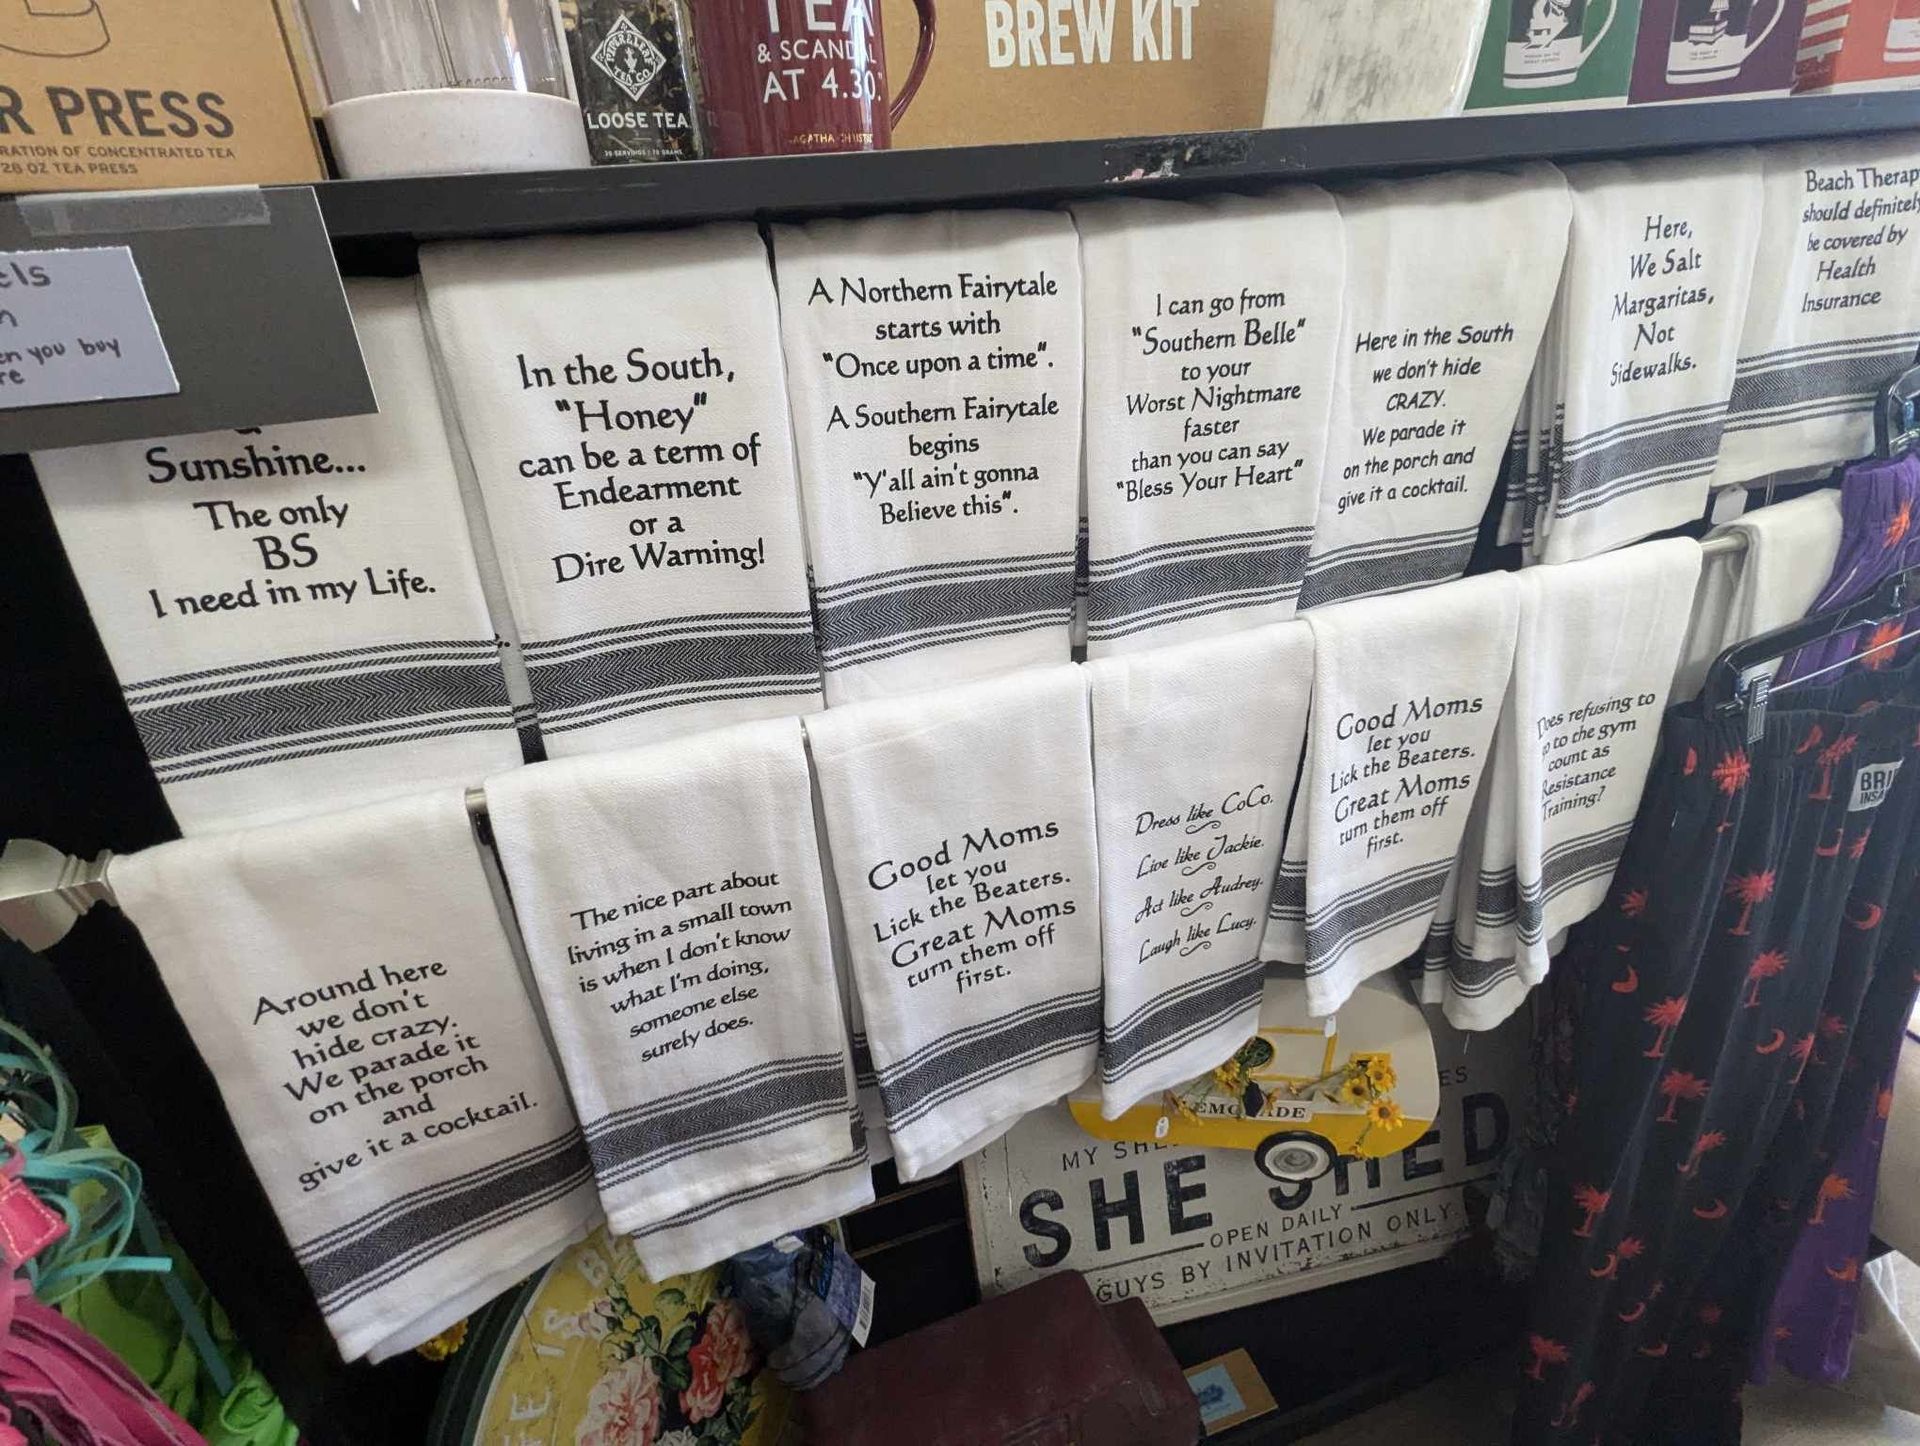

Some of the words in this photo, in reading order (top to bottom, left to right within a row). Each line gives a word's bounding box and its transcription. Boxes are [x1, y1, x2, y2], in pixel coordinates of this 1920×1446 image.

[985, 0, 1115, 68] BREW
[1132, 0, 1200, 62] KIT
[757, 44, 772, 63] &
[764, 69, 805, 103] AT
[46, 85, 235, 138] PRESS
[587, 112, 648, 129] LOOSE
[653, 112, 689, 128] TEA
[53, 163, 85, 174] TEA
[89, 163, 138, 174] PRESS
[63, 145, 82, 157] OF
[88, 146, 205, 158] CONCENTRATED
[207, 147, 236, 159] TEA
[1805, 169, 1855, 193] Beach
[1643, 214, 1693, 243] Here,
[1802, 199, 1853, 224] should
[1806, 232, 1821, 252] be
[1822, 224, 1887, 251] covered
[1886, 223, 1909, 247] by
[1630, 252, 1657, 281] We
[1661, 246, 1703, 275] Salt
[1815, 254, 1877, 282] Health
[807, 276, 835, 307] A
[839, 276, 954, 307] Northern
[957, 270, 1059, 304] Fairytale
[1611, 285, 1715, 321] Margaritas,
[1800, 290, 1882, 314] Insurance
[874, 319, 943, 341] starts
[946, 309, 1002, 337] with
[1131, 325, 1237, 356] "Southern
[1243, 316, 1307, 347] Belle"
[1354, 330, 1398, 355] Here
[1401, 327, 1419, 348] in
[1423, 325, 1453, 347] the
[1456, 321, 1515, 345] South
[1633, 320, 1676, 352] Not
[27, 342, 66, 365] you
[77, 338, 121, 358] buy
[515, 353, 557, 391] In
[562, 352, 619, 386] the
[626, 346, 735, 384] South,
[821, 351, 901, 379] "Once
[905, 355, 963, 380] upon
[966, 354, 982, 372] a
[986, 340, 1054, 371] time".
[1372, 367, 1393, 384] we
[1395, 358, 1439, 381] don't
[1441, 355, 1482, 377] hide
[1610, 350, 1698, 388] Sidewalks.
[1180, 365, 1202, 382] to
[1205, 361, 1252, 385] your
[553, 390, 708, 436] "Honey"
[1125, 392, 1186, 416] Worst
[1190, 383, 1303, 412] Nightmare
[1385, 388, 1447, 413] CRAZY.
[1183, 416, 1241, 444] faster
[145, 444, 367, 484] Sunshine...
[852, 466, 916, 500] "Y'all
[920, 461, 970, 489] ain't
[973, 465, 1040, 490] gonna
[1115, 477, 1174, 503] "Bless
[1178, 470, 1229, 498] Your
[1234, 458, 1305, 488] Heart"
[552, 475, 743, 511] Endearment
[877, 499, 958, 526] Believe
[961, 489, 1019, 517] this".
[191, 500, 273, 532] The
[278, 494, 350, 530] only
[628, 517, 659, 537] or
[666, 515, 686, 534] a
[251, 531, 319, 571] BS
[550, 551, 626, 585] Dire
[628, 536, 765, 571] Warning!
[1336, 702, 1399, 741] Good
[1401, 695, 1483, 728] Moms
[1590, 745, 1611, 760] as
[1134, 810, 1181, 837] Dress
[1185, 801, 1215, 823] like
[1220, 783, 1274, 815] CoCo.
[1335, 789, 1390, 822] Great
[1393, 773, 1471, 804] Moms
[868, 840, 952, 890] Good
[961, 821, 1060, 862] Moms
[1135, 853, 1170, 880] Live
[1173, 844, 1202, 866] like
[1205, 833, 1265, 861] Jackie.
[925, 872, 959, 895] let
[963, 859, 1007, 886] you
[569, 907, 620, 931] The
[621, 893, 669, 917] nice
[671, 881, 718, 908] part
[719, 870, 781, 892] about
[872, 907, 926, 944] Lick
[928, 895, 968, 919] the
[971, 871, 1072, 904] Beaters.
[1134, 895, 1165, 925] Act
[1168, 887, 1195, 909] like
[1198, 873, 1264, 900] Audrey.
[891, 923, 975, 968] Great
[984, 900, 1076, 937] Moms
[1138, 928, 1182, 965] Laugh
[1185, 922, 1212, 944] like
[1215, 911, 1257, 935] Lucy.
[906, 958, 954, 989] turn
[959, 938, 1019, 965] them
[1024, 921, 1056, 949] off
[252, 967, 379, 1026] Around
[377, 962, 448, 987] here
[609, 984, 667, 1014] what
[669, 972, 703, 994] I'm
[705, 959, 770, 983] doing,
[955, 964, 1012, 995] first.
[295, 1014, 346, 1039] we
[351, 988, 430, 1023] don't
[629, 997, 718, 1039] someone
[719, 985, 760, 1005] else
[290, 1033, 366, 1071] hide
[370, 1014, 461, 1047] crazy.
[641, 1028, 701, 1063] surely
[704, 1016, 754, 1039] does.
[382, 1091, 437, 1126] and
[1062, 1146, 1098, 1171] MY
[1018, 1154, 1214, 1269] SHE
[1210, 1221, 1270, 1249] OPEN
[1281, 1204, 1343, 1233] DAILY
[1096, 1272, 1165, 1303] GUYS
[1182, 1261, 1211, 1284] BY
[1226, 1221, 1372, 1273] INVITATION
